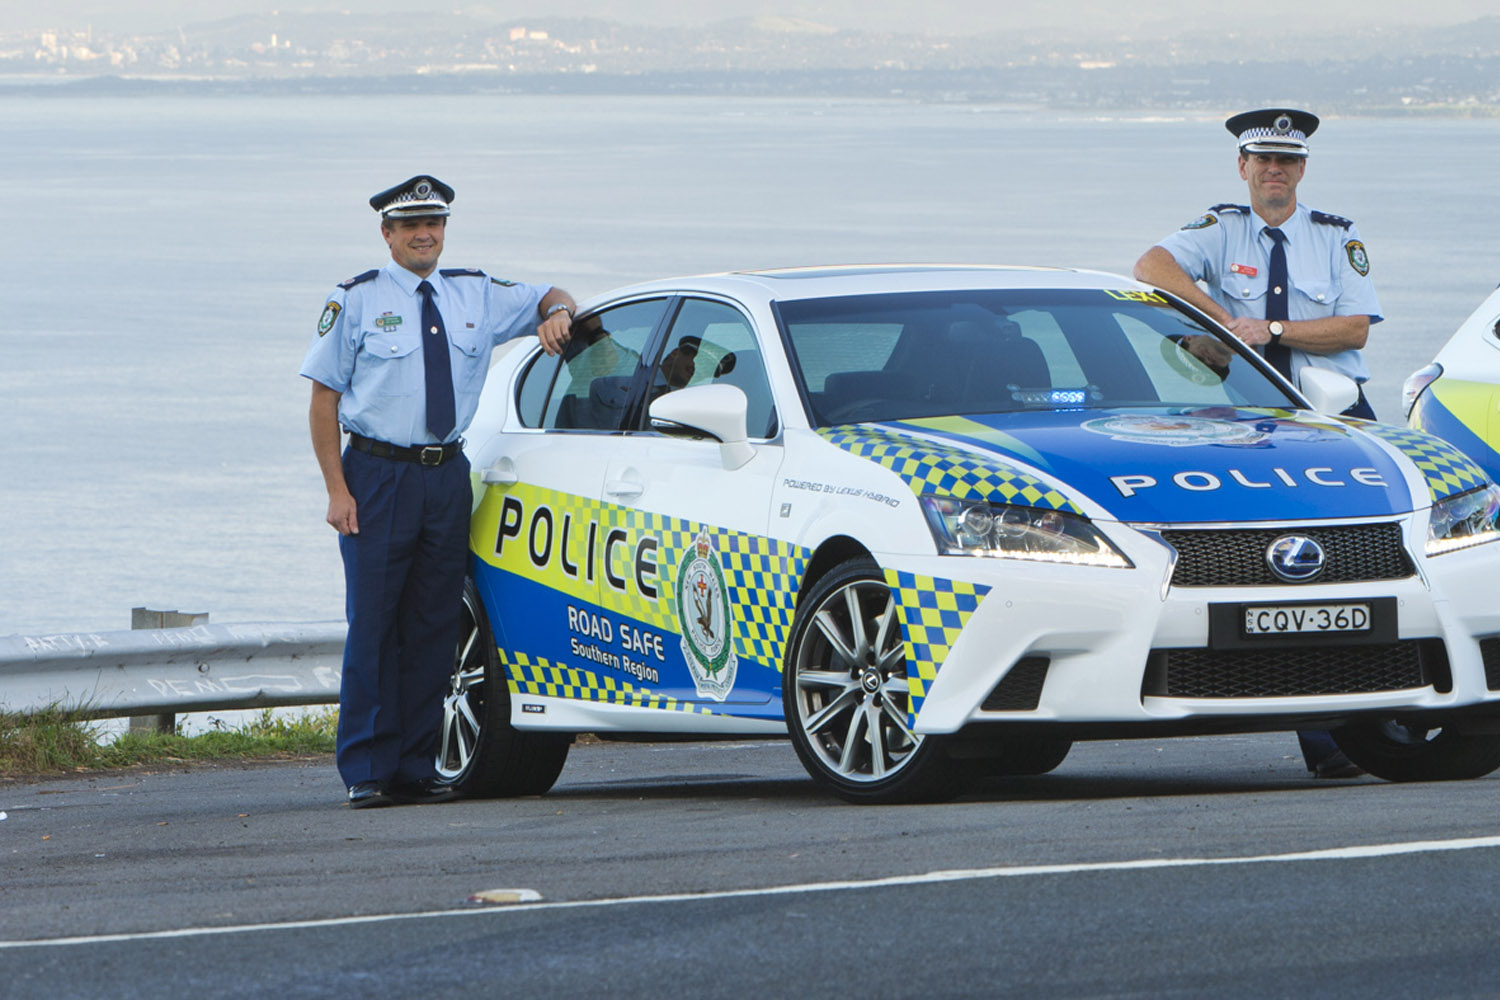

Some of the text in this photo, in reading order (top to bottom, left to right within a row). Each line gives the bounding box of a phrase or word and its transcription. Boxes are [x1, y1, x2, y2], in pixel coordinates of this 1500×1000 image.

[783, 478, 900, 508] POWERED BY LEXUS HYBRID
[1109, 467, 1390, 498] POLICE
[494, 495, 659, 602] POLICE
[567, 605, 665, 661] ROAD SAFE
[570, 637, 620, 670] Southern
[623, 656, 659, 684] Region
